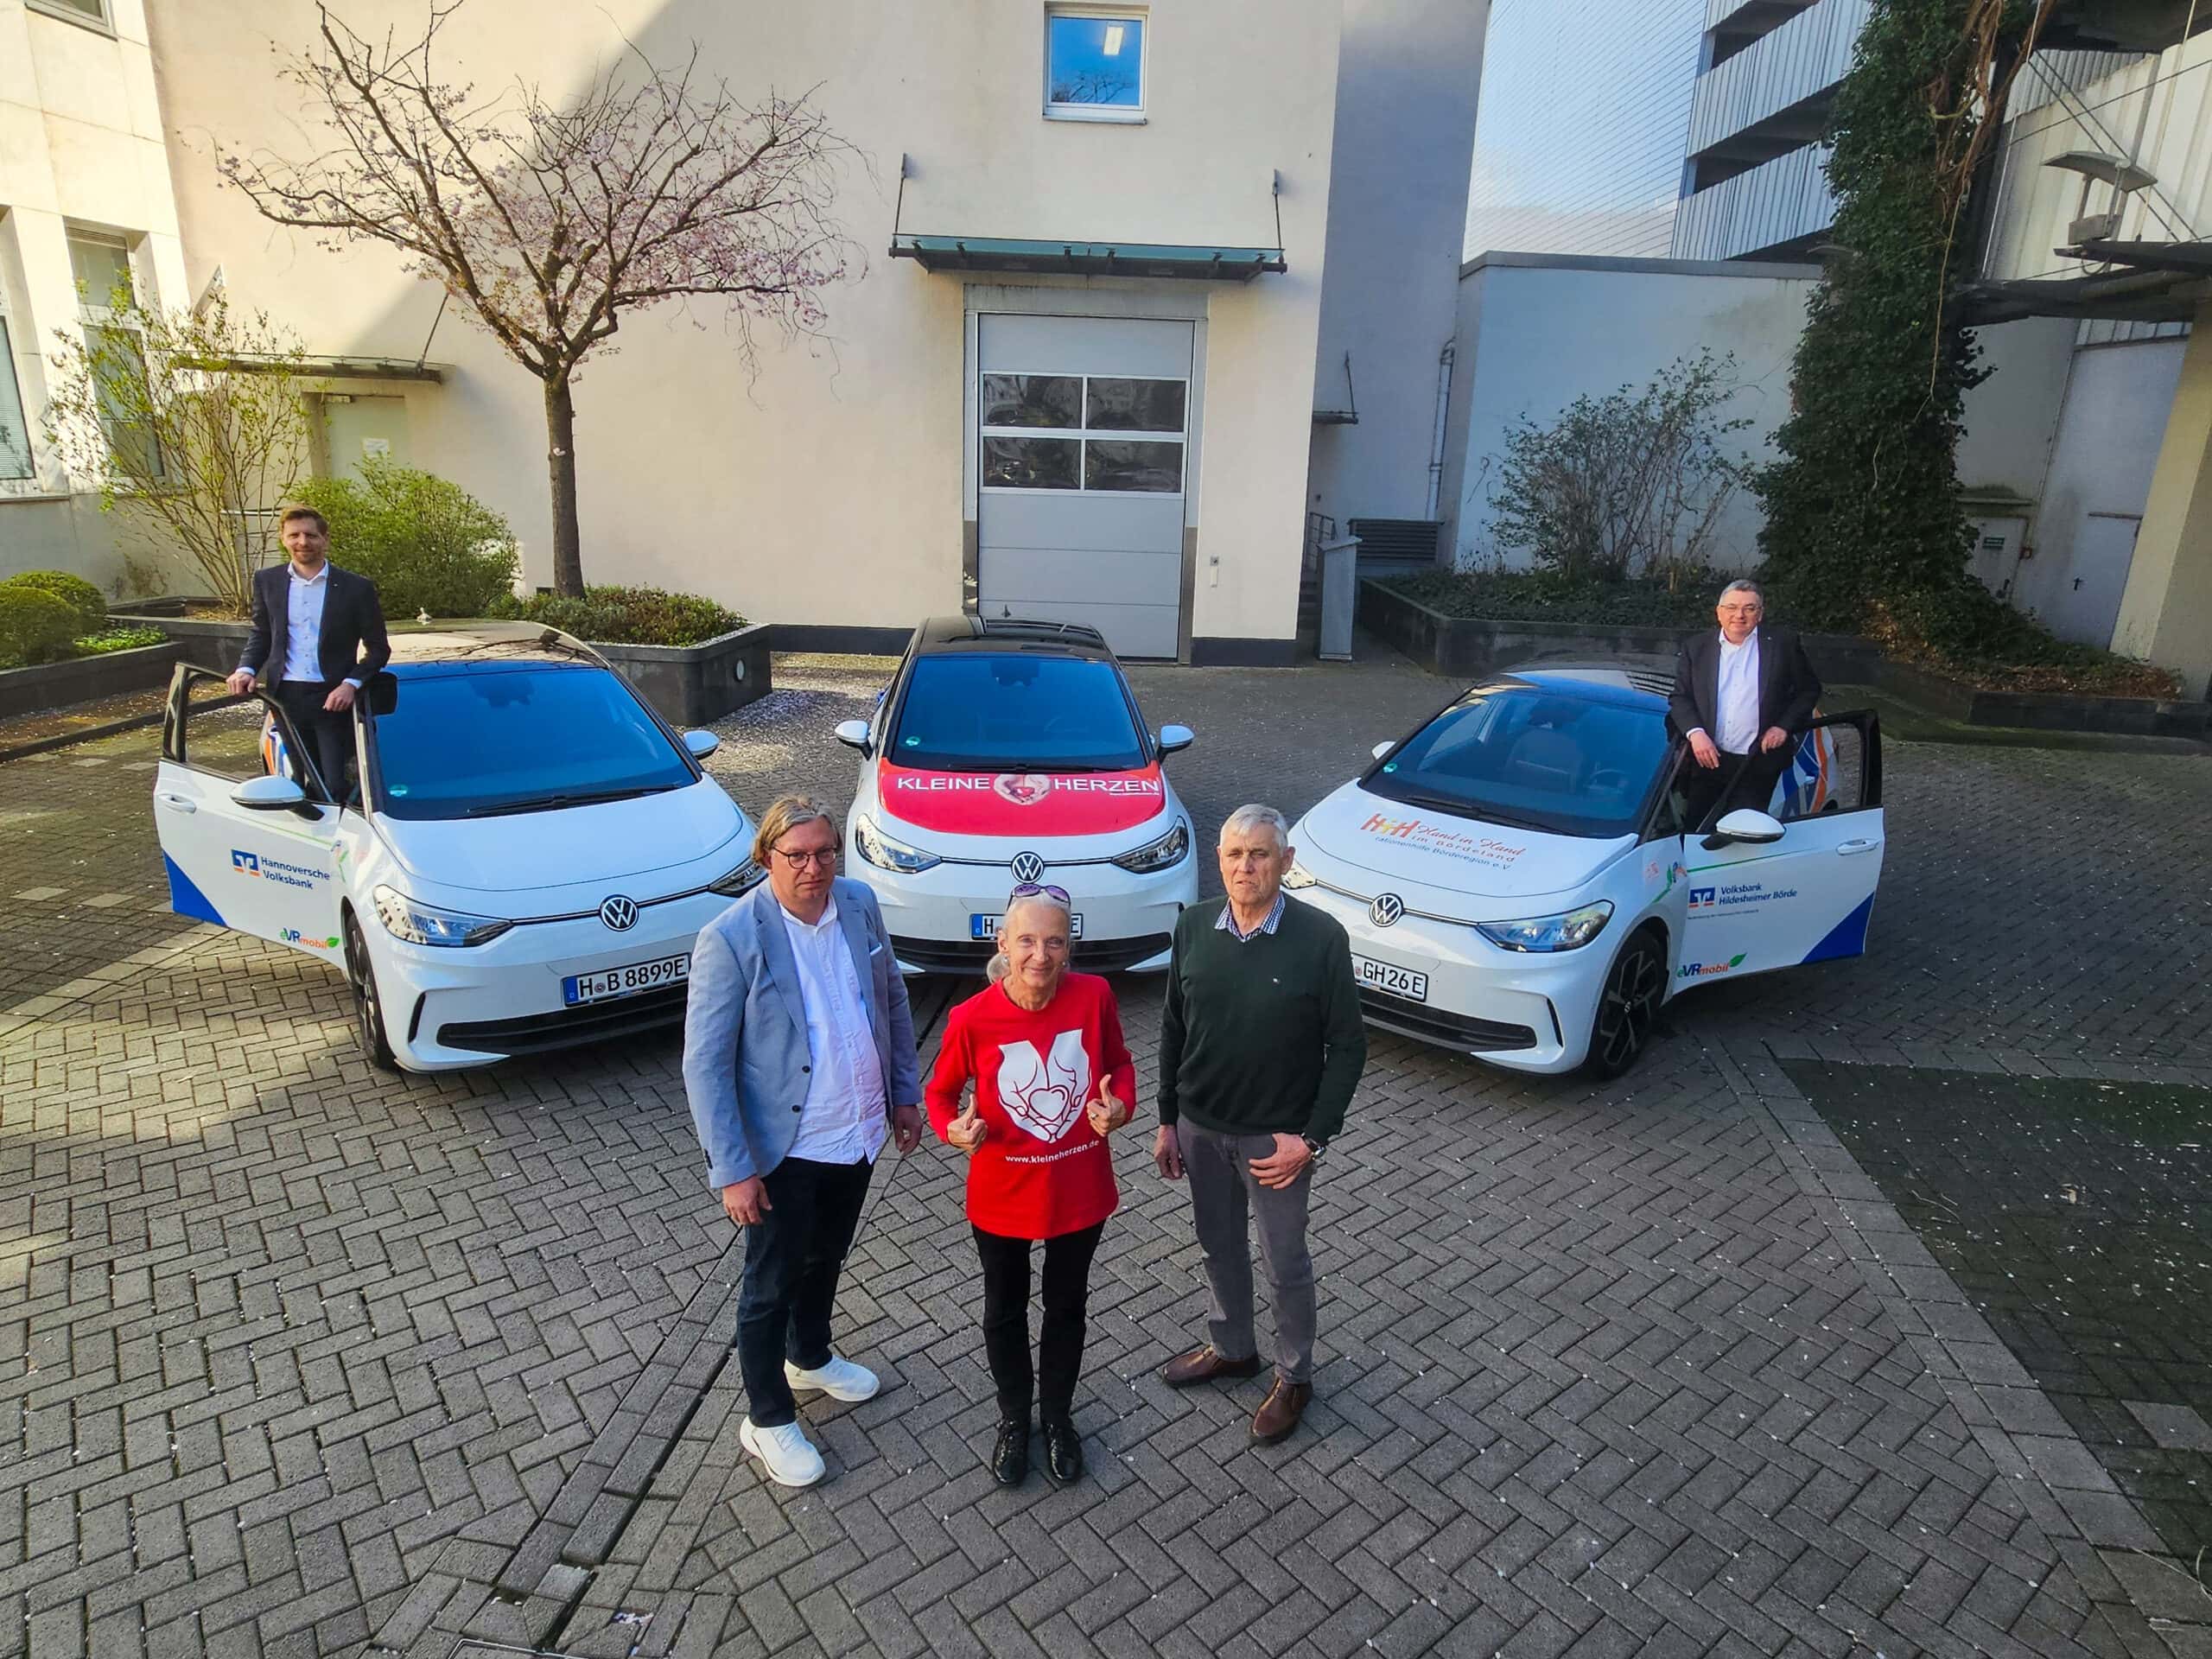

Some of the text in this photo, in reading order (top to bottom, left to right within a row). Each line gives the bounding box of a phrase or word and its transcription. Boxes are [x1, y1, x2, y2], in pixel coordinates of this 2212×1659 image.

[897, 777, 1160, 792] KLEINE HERZEN
[1417, 825, 1527, 856] Hand in Hand
[261, 856, 331, 880] Hannoversche
[263, 870, 314, 890] Volksbank
[1720, 882, 1764, 895] Volksbank
[1719, 888, 1798, 906] Hildesheimer Börde
[1005, 1140, 1099, 1164] www.kleineherzen.de
